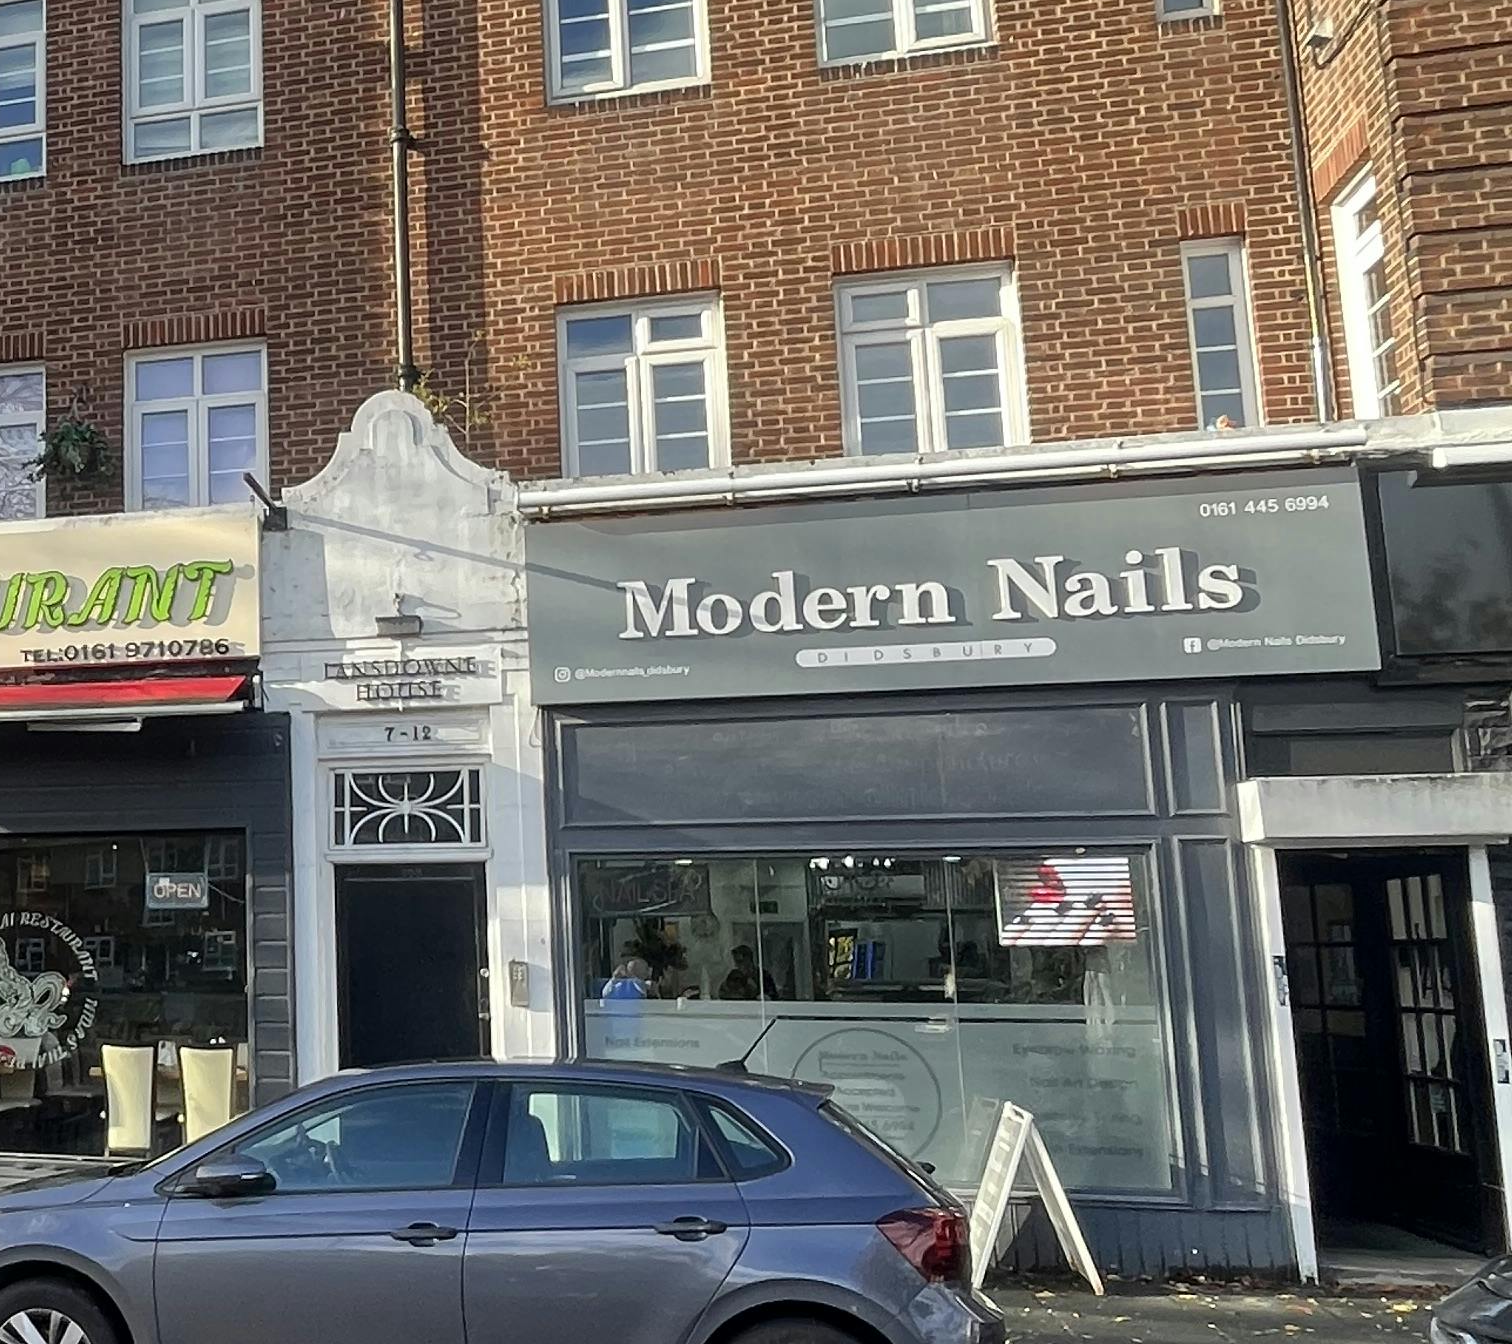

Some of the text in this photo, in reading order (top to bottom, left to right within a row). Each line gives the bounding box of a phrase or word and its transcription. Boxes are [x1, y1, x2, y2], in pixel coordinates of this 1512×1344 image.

[1199, 495, 1329, 517] 0161 445 6994
[617, 546, 1244, 639] Modern Nails
[125, 638, 229, 658] 9710786
[817, 642, 1033, 664] DIDSBURY
[324, 656, 477, 679] LANSDOWNE
[356, 681, 443, 701] HOUSE
[153, 882, 202, 898] OPEN
[20, 911, 98, 982] RESTAURANT
